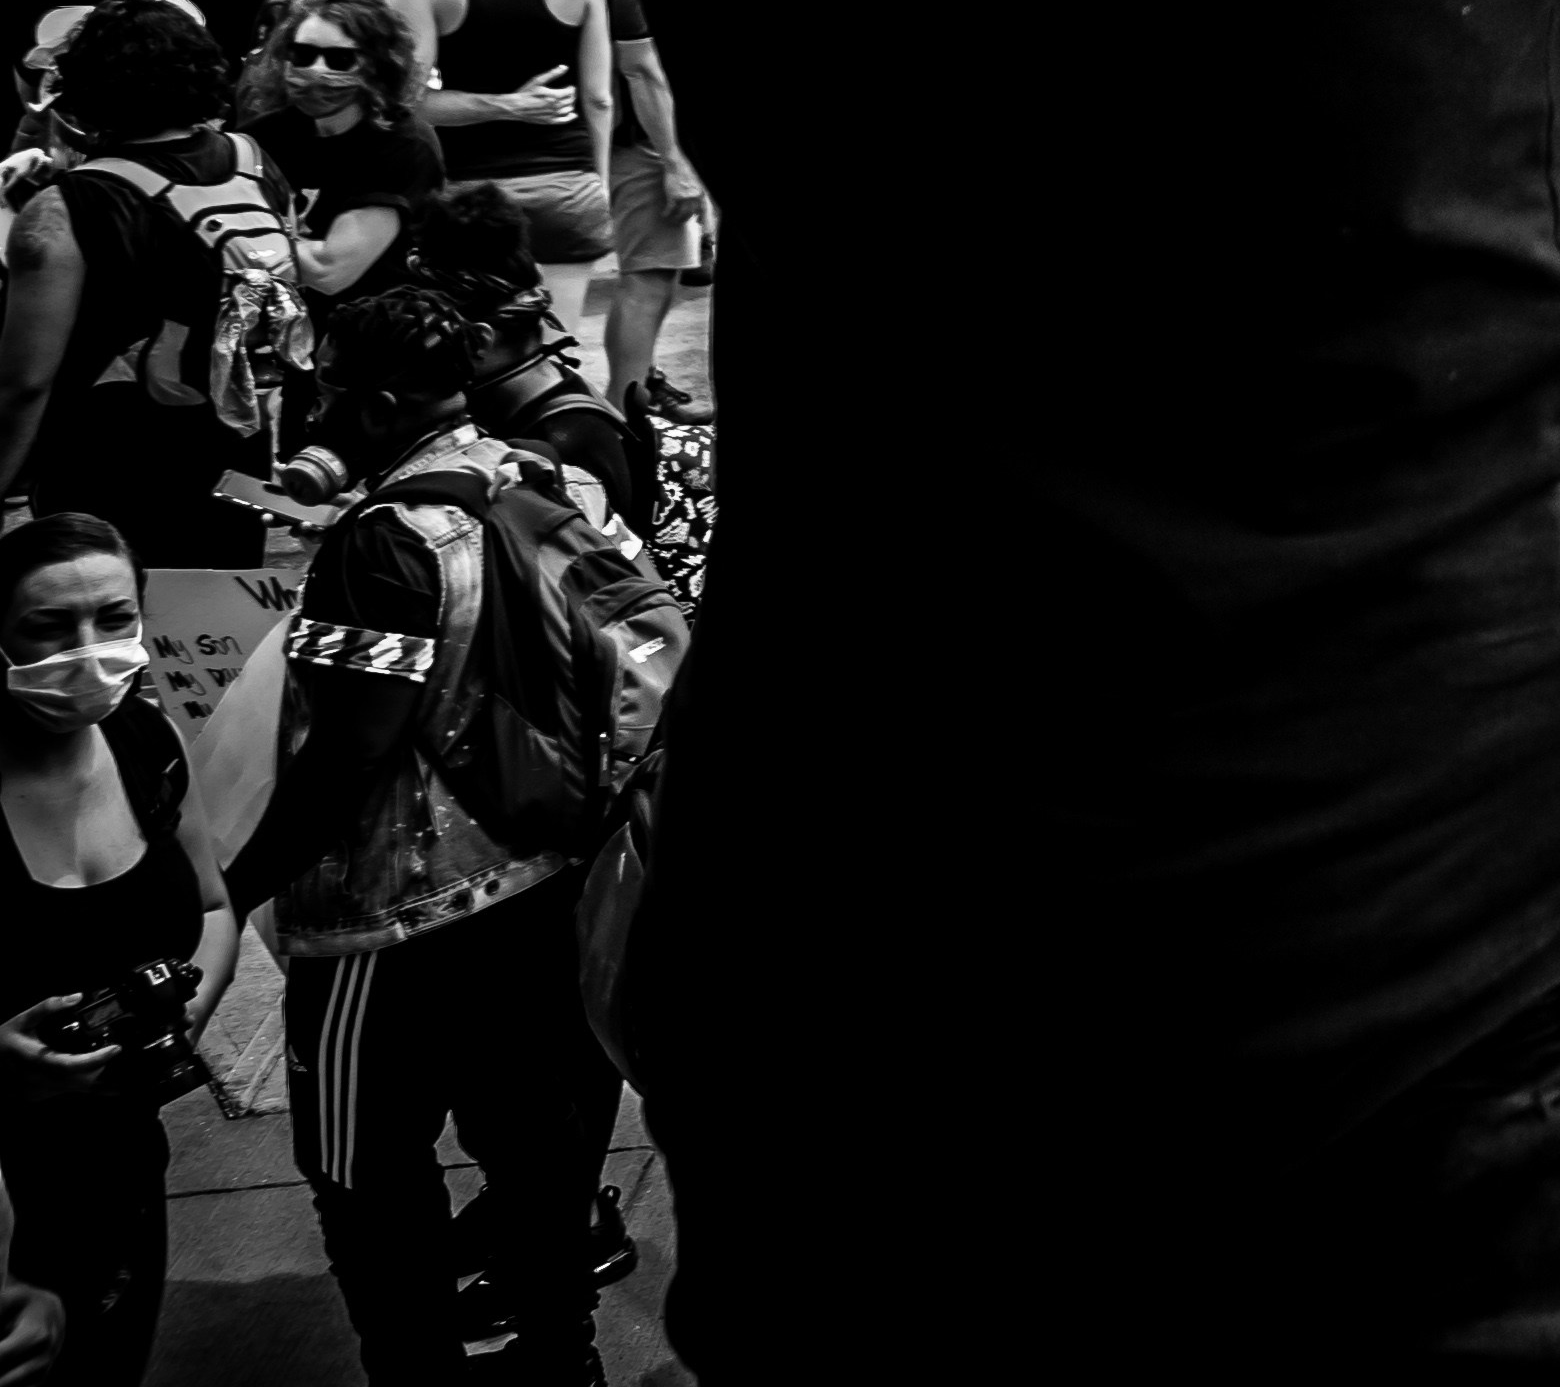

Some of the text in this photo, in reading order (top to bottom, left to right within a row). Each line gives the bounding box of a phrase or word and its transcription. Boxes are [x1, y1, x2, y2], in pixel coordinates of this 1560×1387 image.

[153, 632, 245, 665] My Son
[165, 670, 207, 697] My
